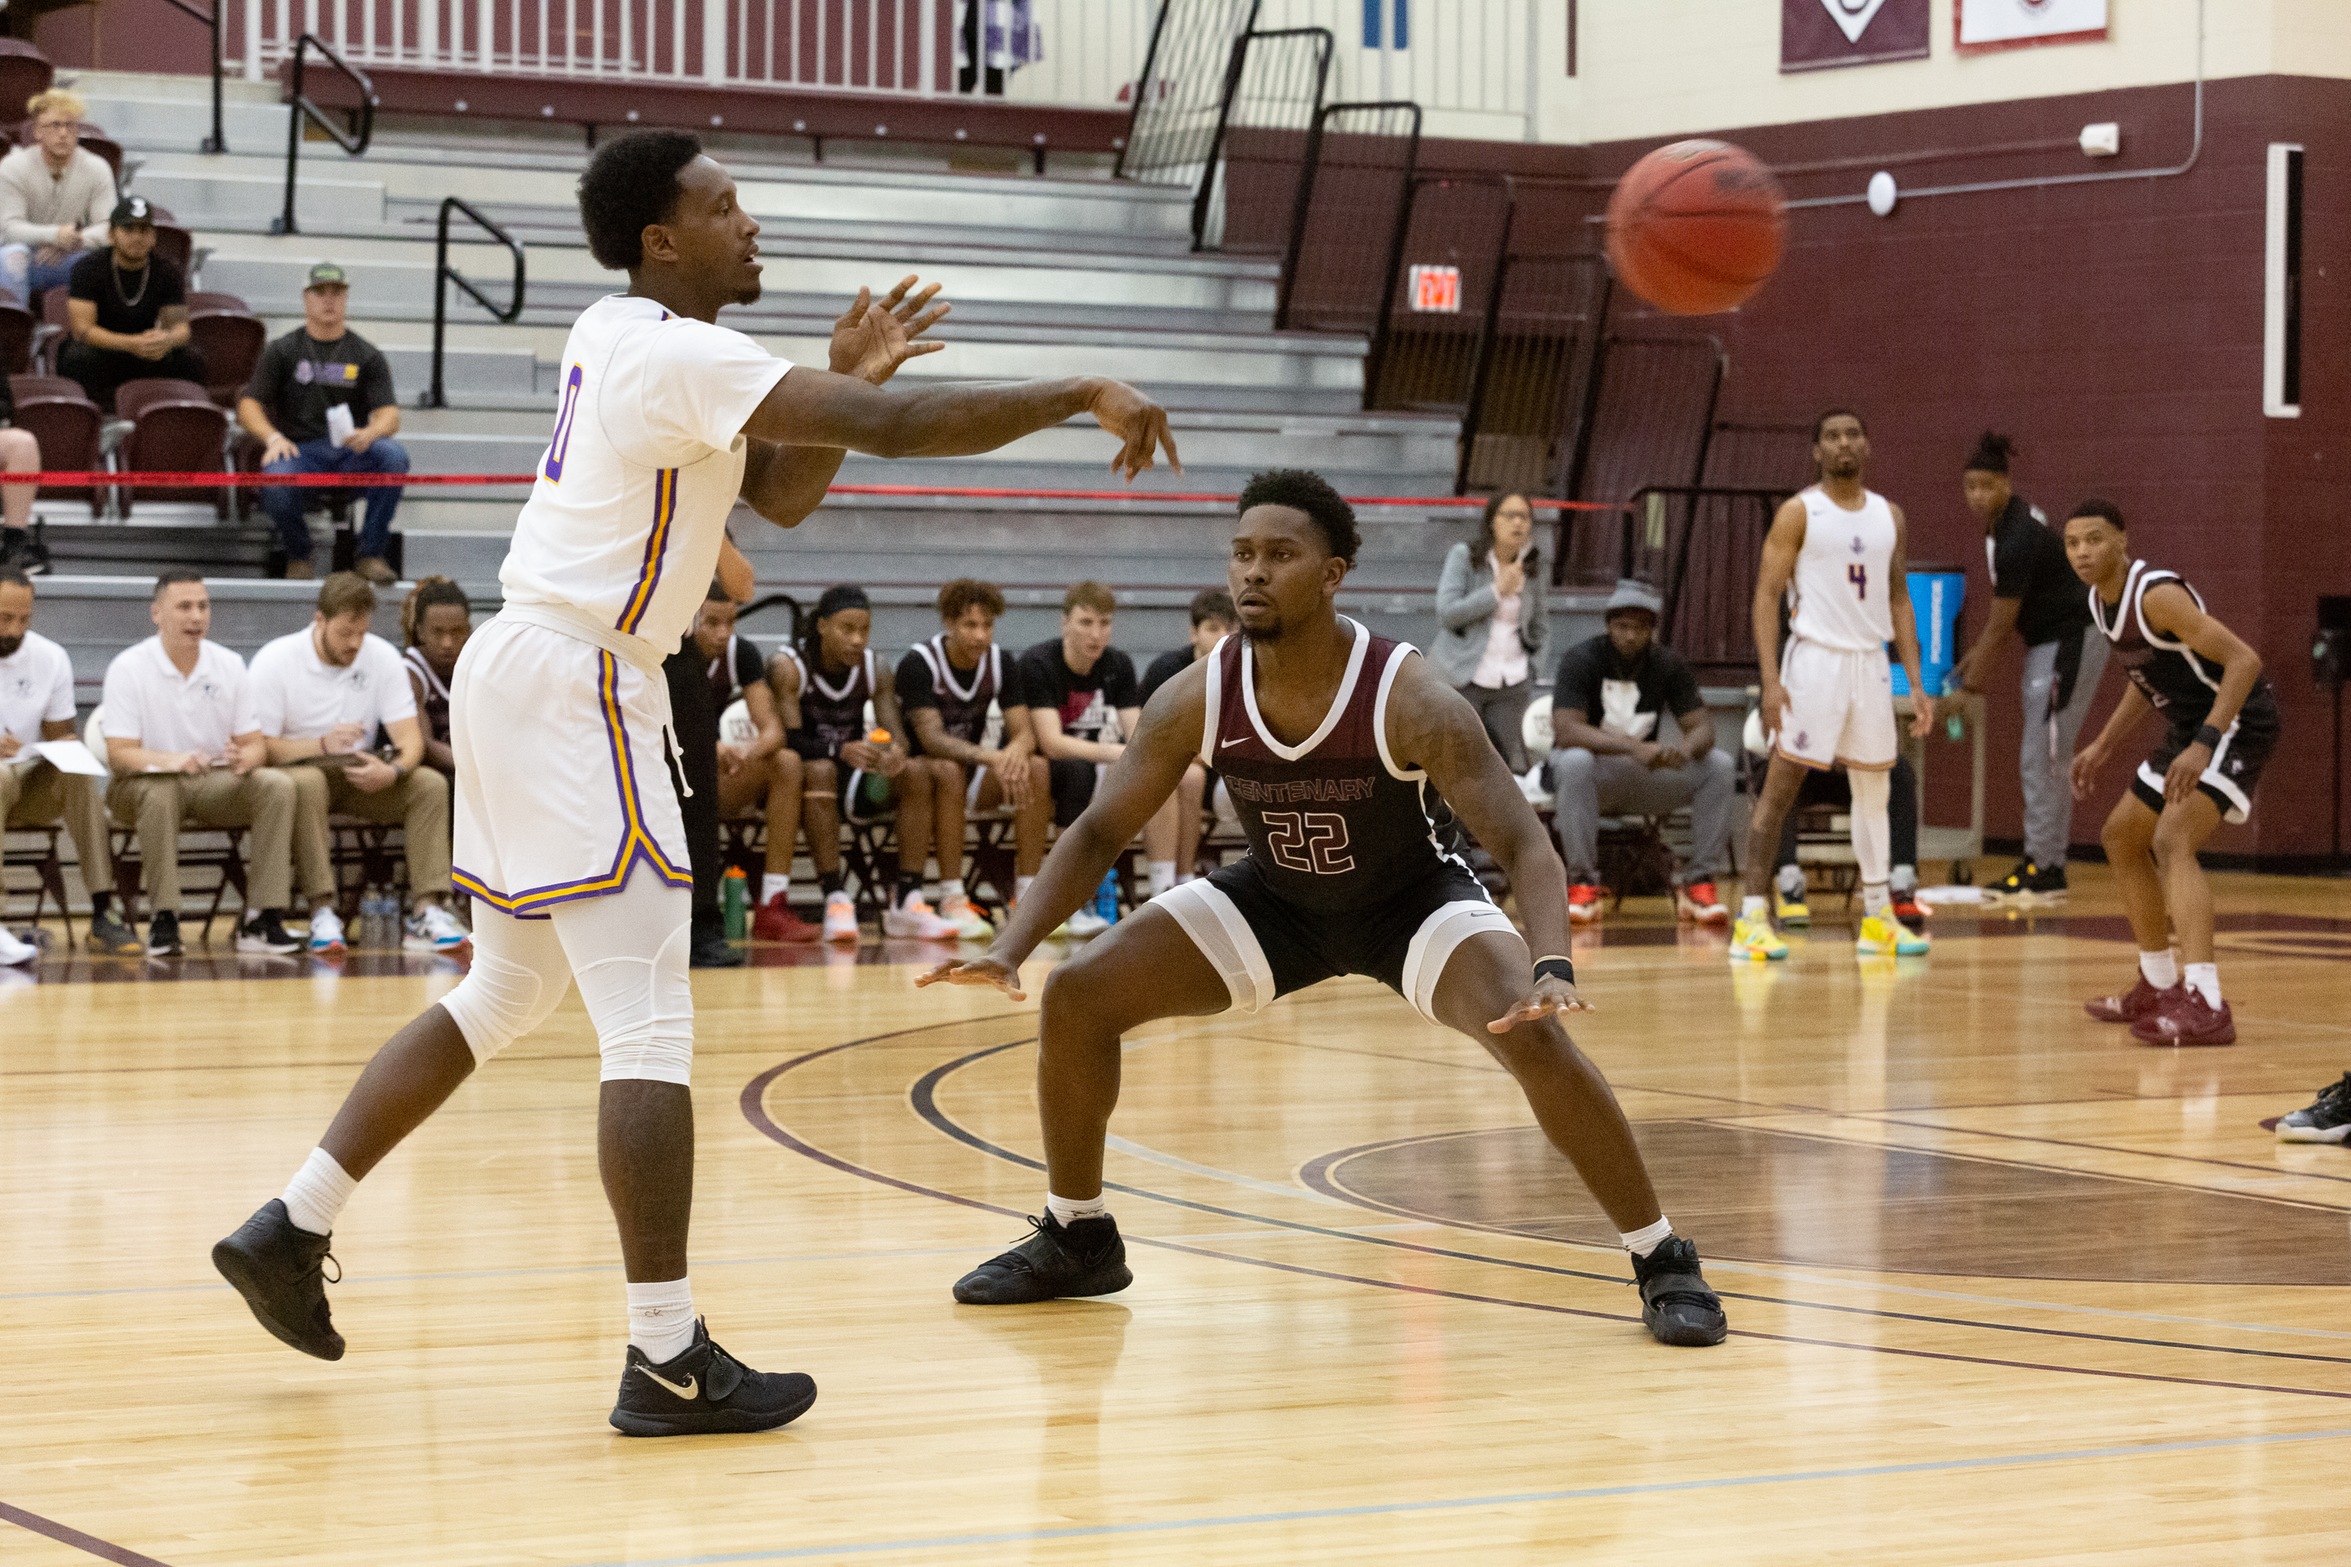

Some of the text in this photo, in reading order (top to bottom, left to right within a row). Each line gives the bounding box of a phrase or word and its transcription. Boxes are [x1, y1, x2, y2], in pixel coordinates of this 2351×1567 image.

[544, 362, 583, 486] 0
[1848, 563, 1867, 601] 4
[1225, 775, 1376, 803] CENTENARY
[1262, 811, 1355, 875] 22
